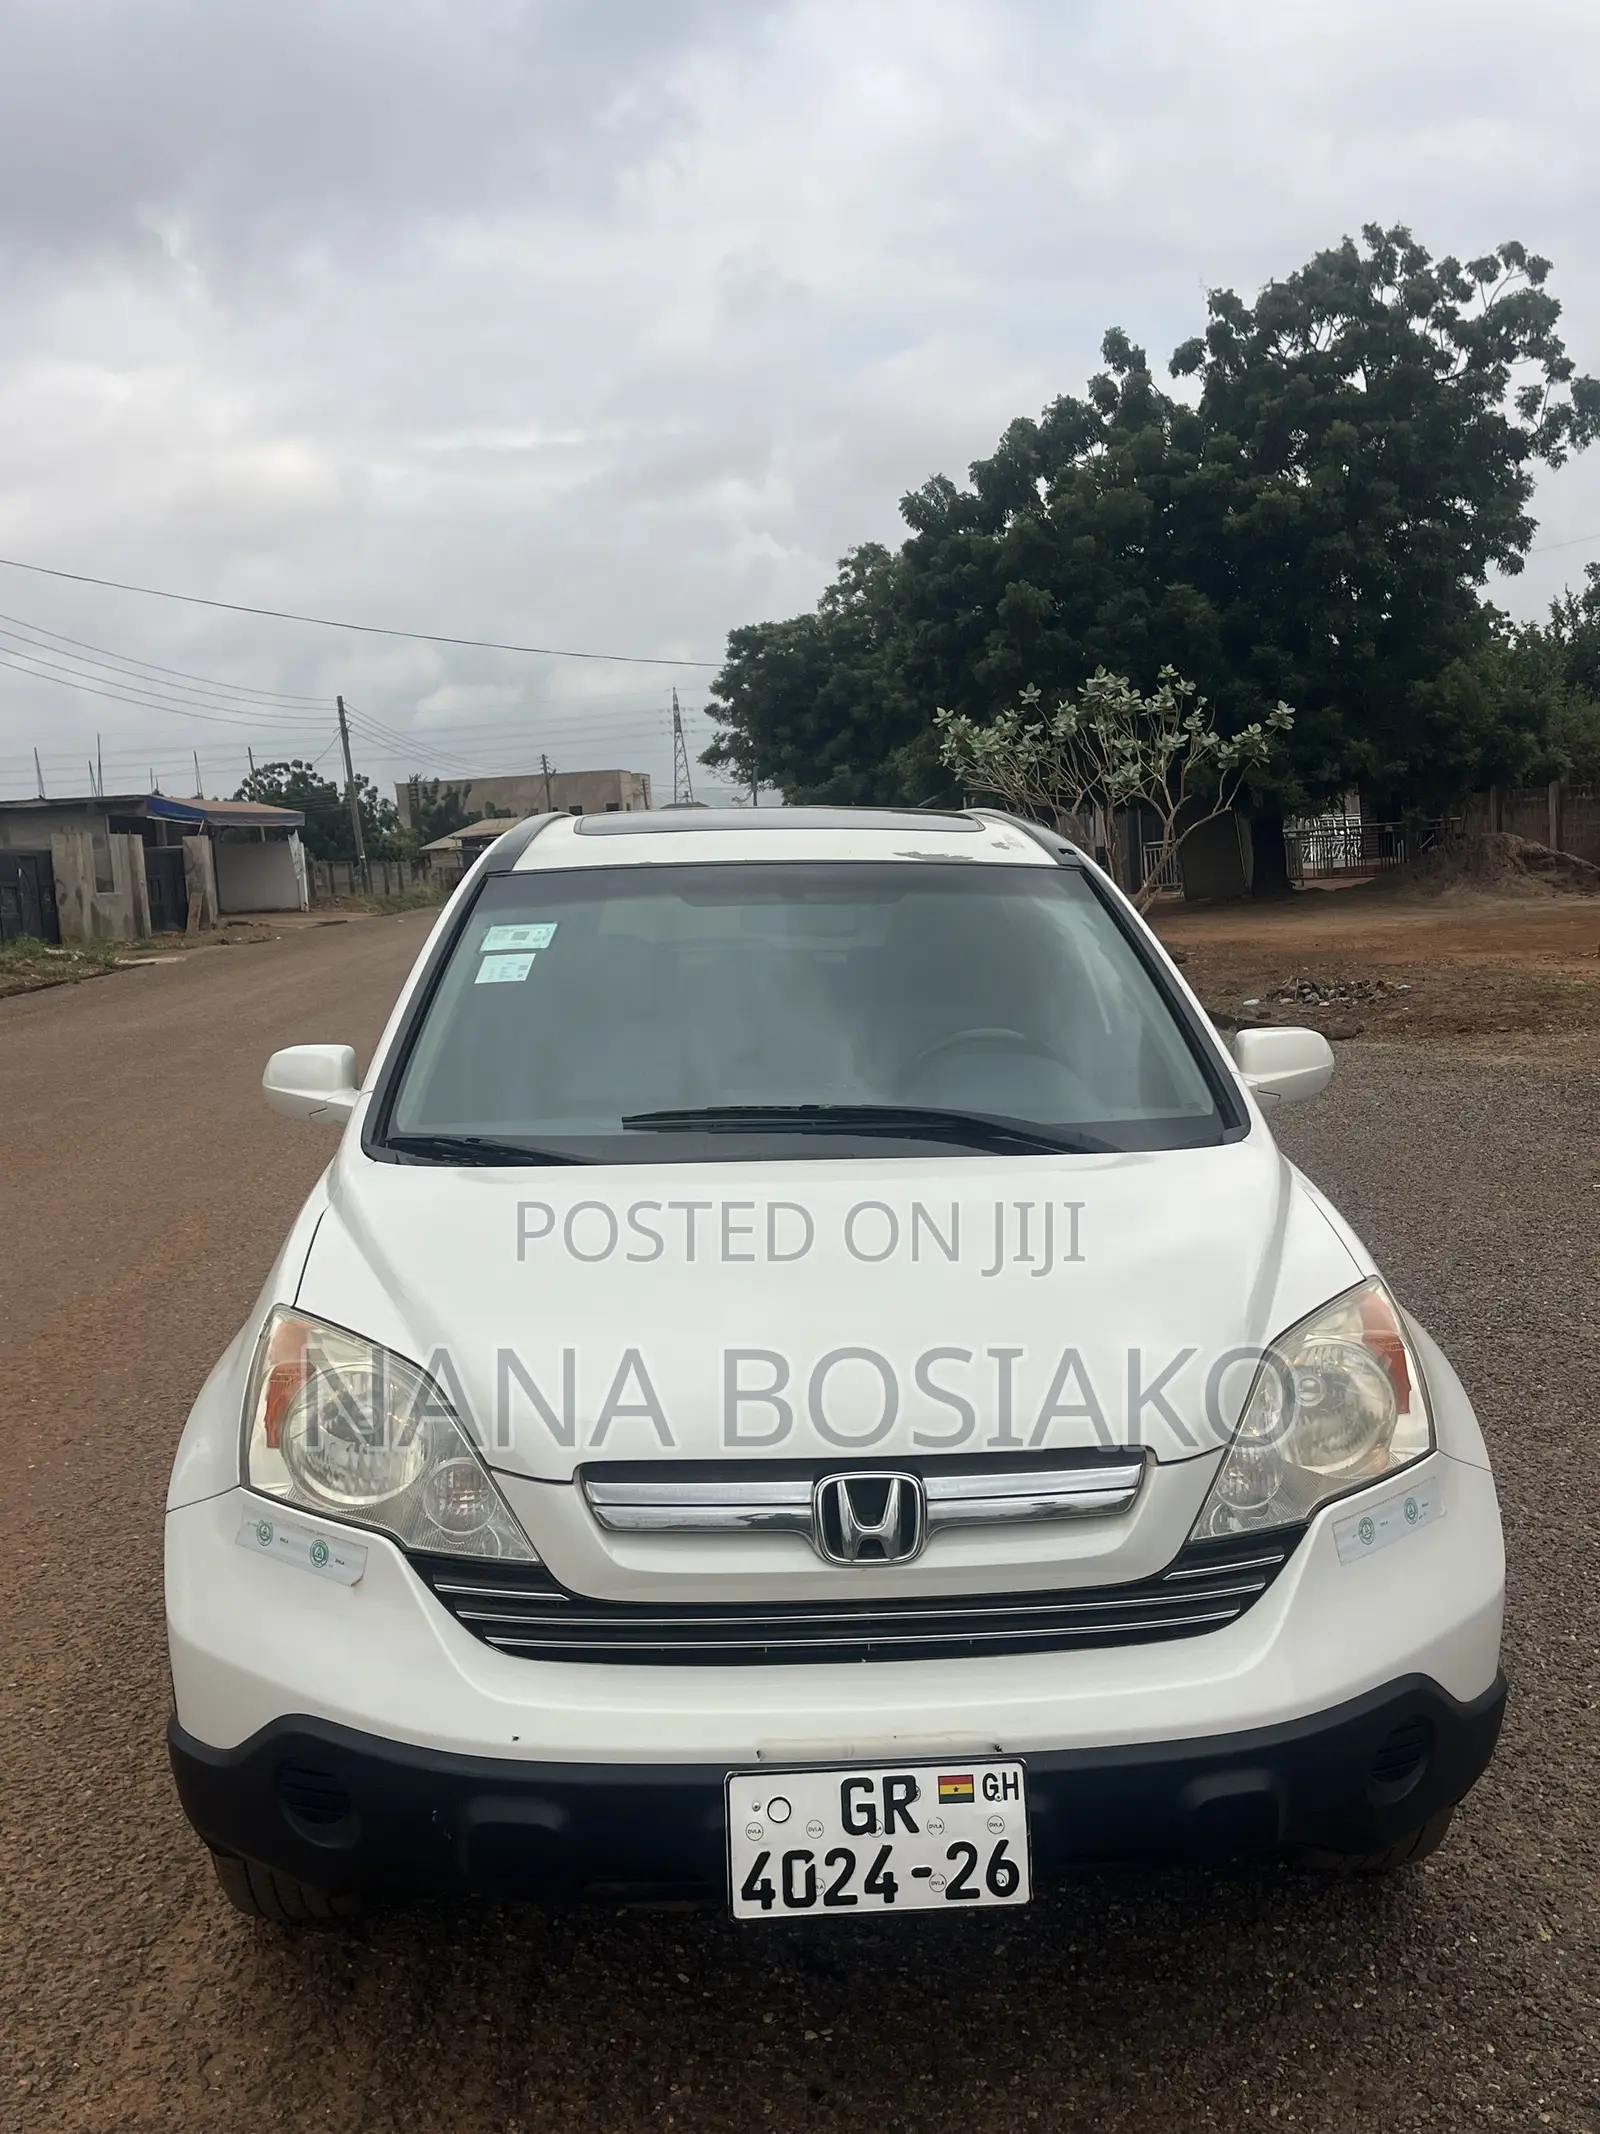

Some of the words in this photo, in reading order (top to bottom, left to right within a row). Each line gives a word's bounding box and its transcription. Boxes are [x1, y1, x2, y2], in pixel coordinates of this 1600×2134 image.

[840, 1774, 920, 1836] GR
[982, 1771, 1019, 1802] GH
[741, 1839, 1020, 1910] 4024-26
